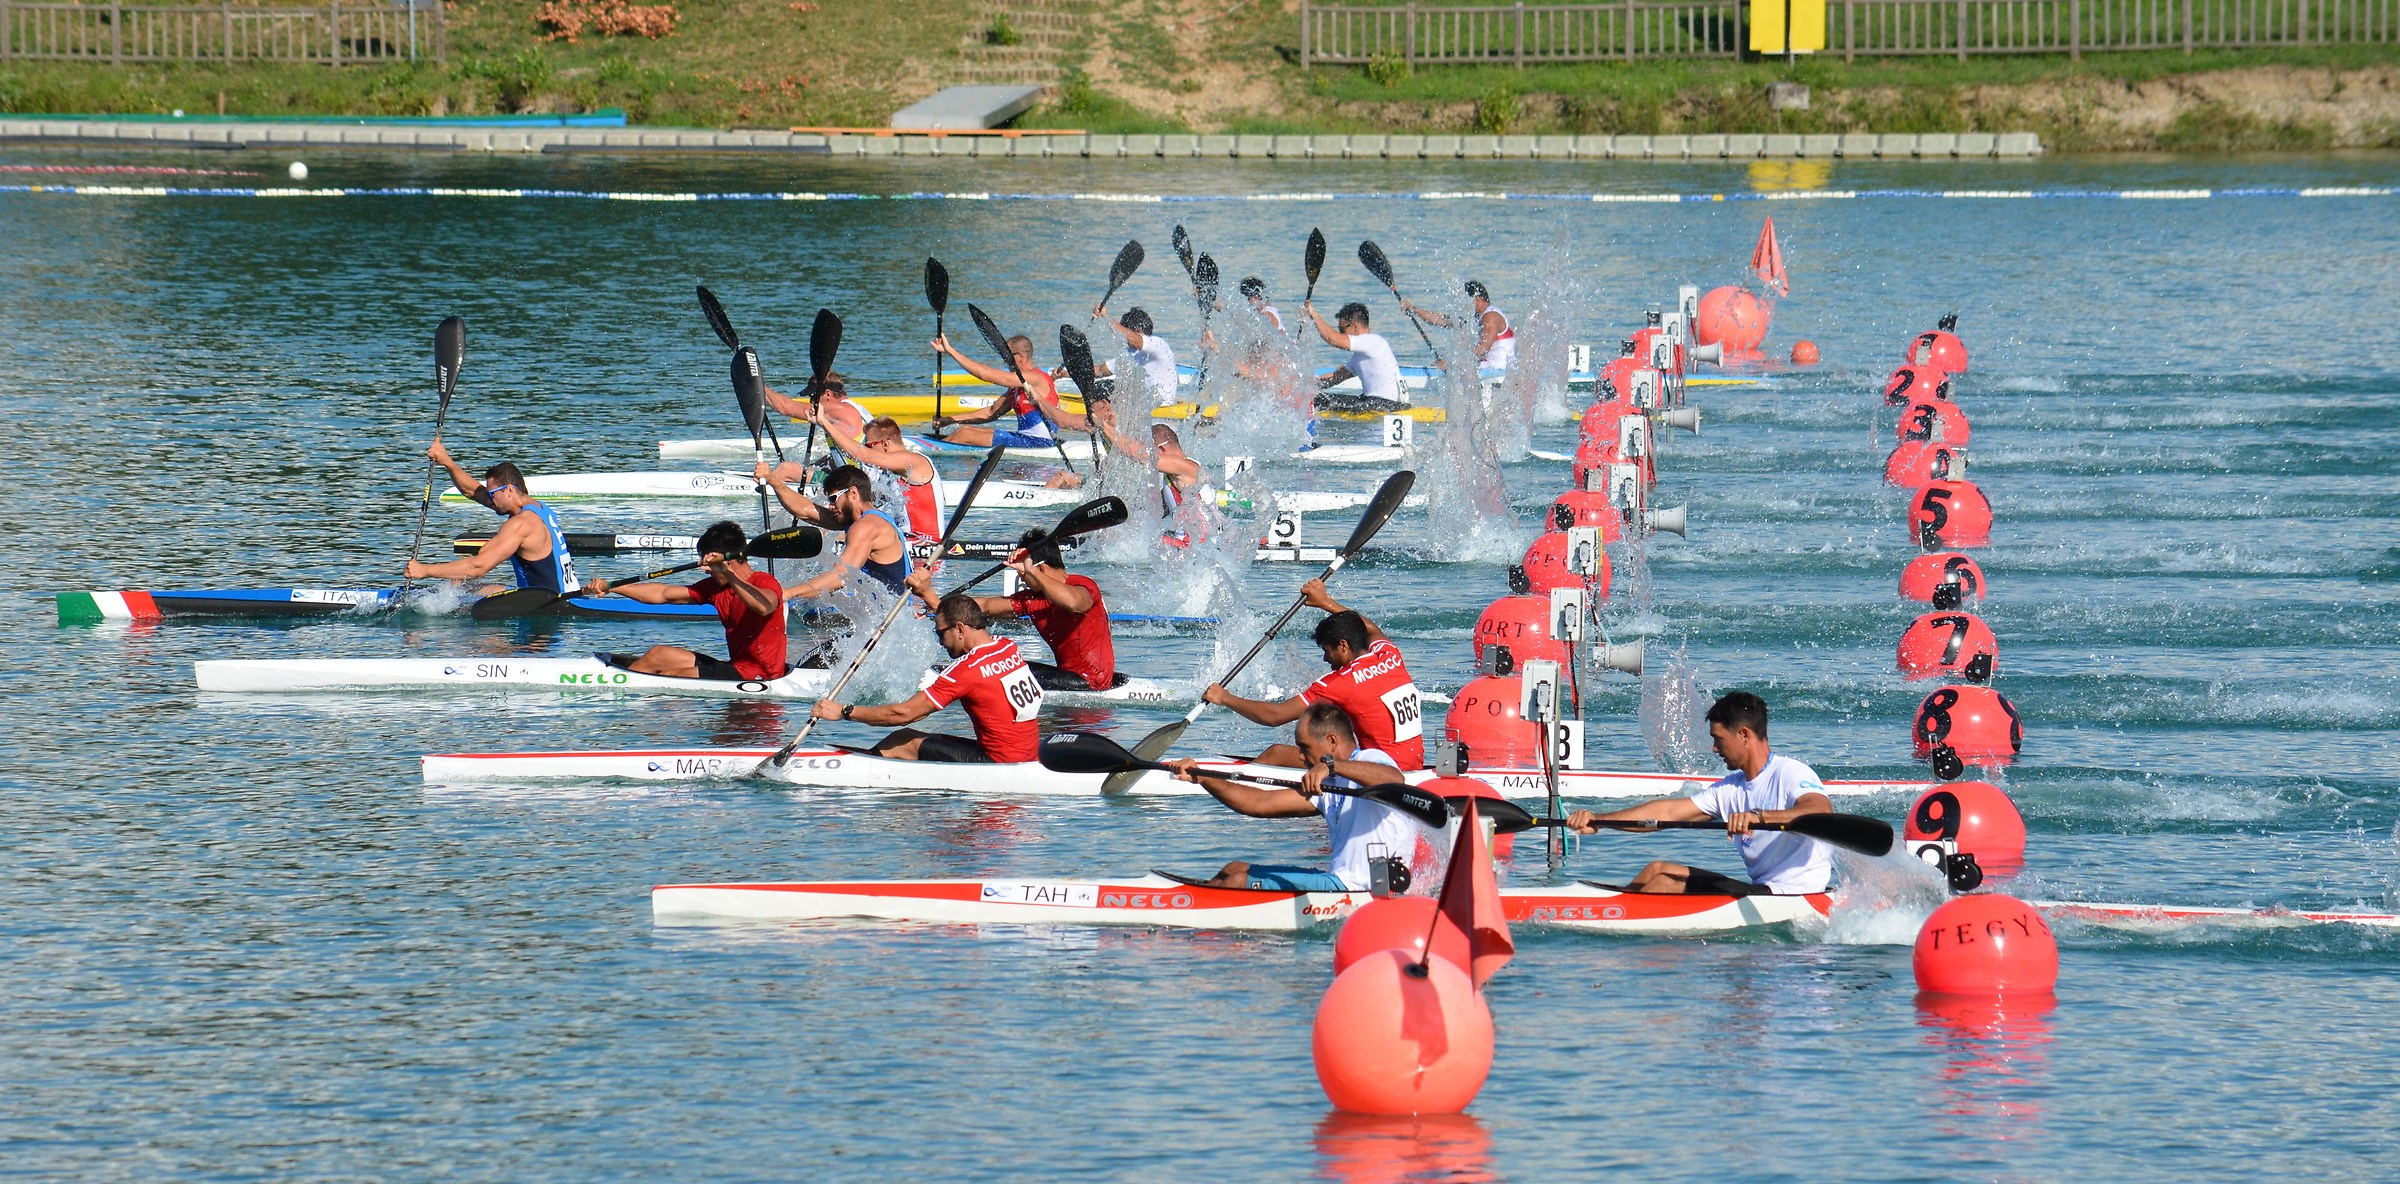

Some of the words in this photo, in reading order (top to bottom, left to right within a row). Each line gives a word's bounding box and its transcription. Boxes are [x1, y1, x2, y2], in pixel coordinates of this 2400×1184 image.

[1889, 369, 1915, 407] 2
[1392, 418, 1403, 442] 3
[1905, 404, 1937, 441] 3
[1003, 490, 1035, 500] AUS
[1919, 487, 1952, 535] 5
[1274, 511, 1296, 538] 5
[639, 535, 673, 548] GER
[965, 543, 984, 551] Dein
[985, 543, 1009, 551] Name
[1944, 556, 1978, 600] 6
[322, 591, 350, 602] ITA
[1930, 615, 1970, 666] 7
[476, 664, 509, 678] SIN
[559, 673, 628, 684] NELO
[1009, 675, 1042, 708] 664
[1393, 692, 1419, 726] 663
[1917, 688, 1959, 743] 8
[676, 758, 722, 774] MAR
[1502, 775, 1550, 790] MAR
[1916, 791, 1961, 841] 9
[1021, 885, 1068, 904] TAH
[1103, 894, 1194, 909] NELO
[1533, 906, 1624, 920] NELO
[1931, 914, 2051, 951] TEGYS
